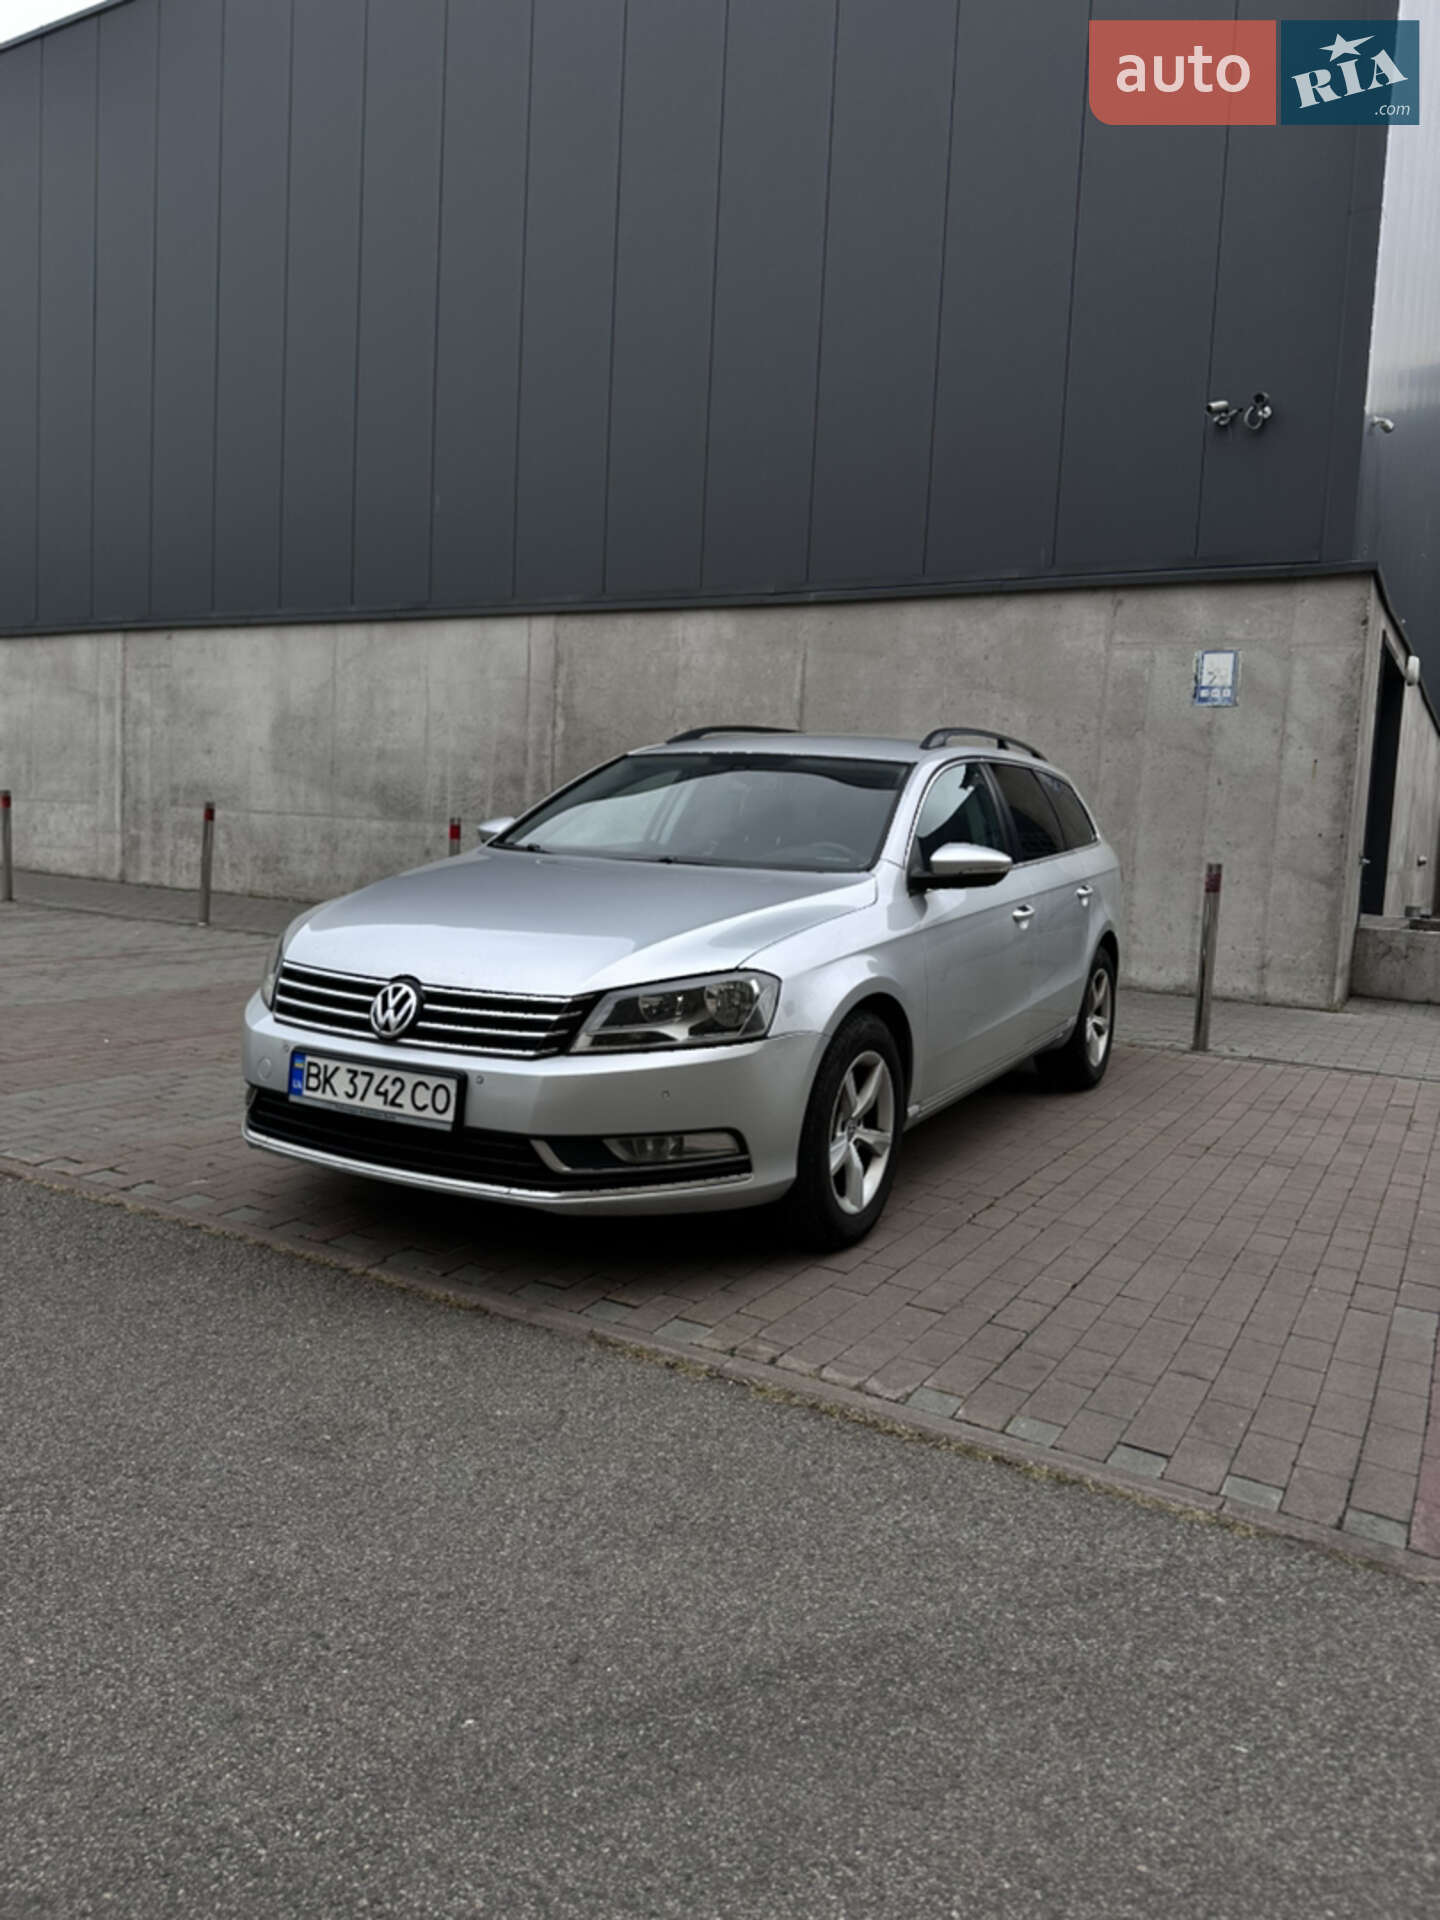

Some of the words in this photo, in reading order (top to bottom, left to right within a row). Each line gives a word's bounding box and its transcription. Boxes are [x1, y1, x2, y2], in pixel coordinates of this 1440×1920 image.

[305, 1062, 341, 1097] BK
[344, 1068, 406, 1108] 3742
[411, 1080, 451, 1114] CO
